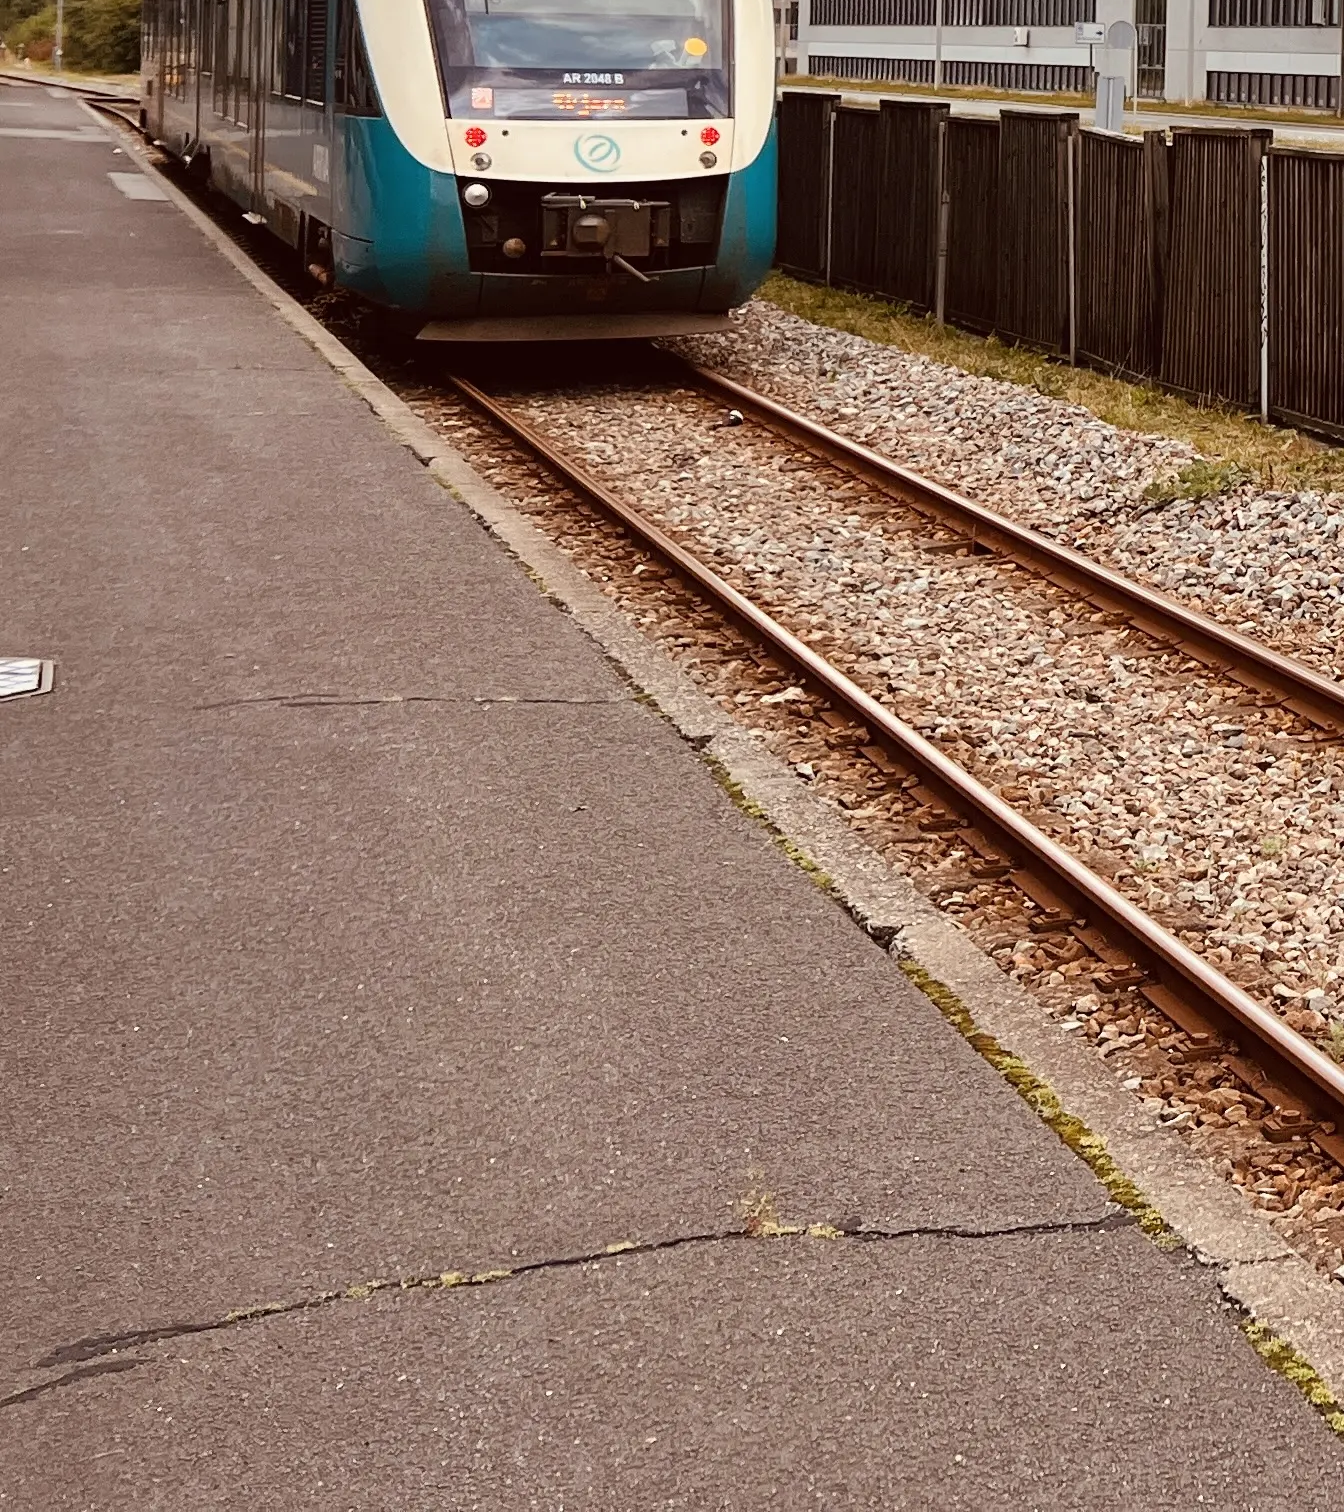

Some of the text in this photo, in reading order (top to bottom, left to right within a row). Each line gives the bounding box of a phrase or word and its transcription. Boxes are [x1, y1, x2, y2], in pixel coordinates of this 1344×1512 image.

[563, 72, 624, 85] AR 2048 B
